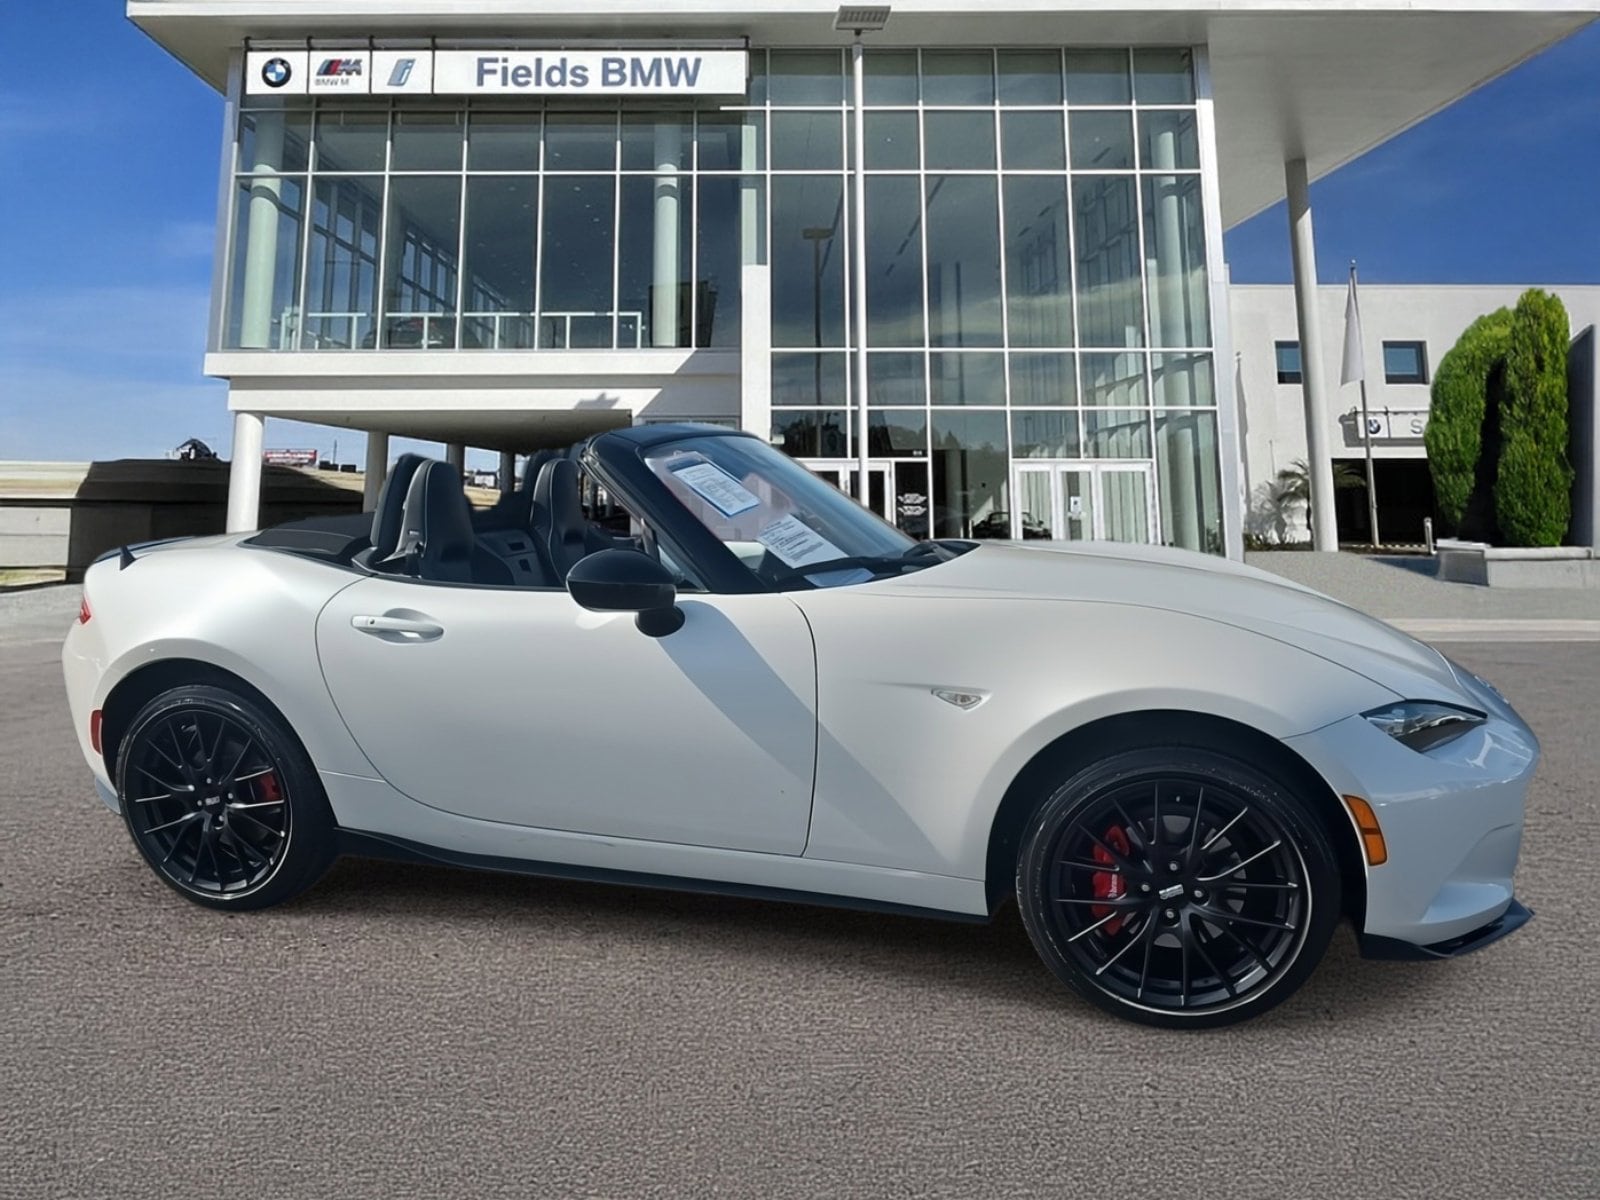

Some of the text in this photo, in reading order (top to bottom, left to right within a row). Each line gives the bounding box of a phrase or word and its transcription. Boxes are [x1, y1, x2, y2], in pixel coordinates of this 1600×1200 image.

[476, 57, 702, 87] Fields BMW
[315, 78, 339, 86] BMW
